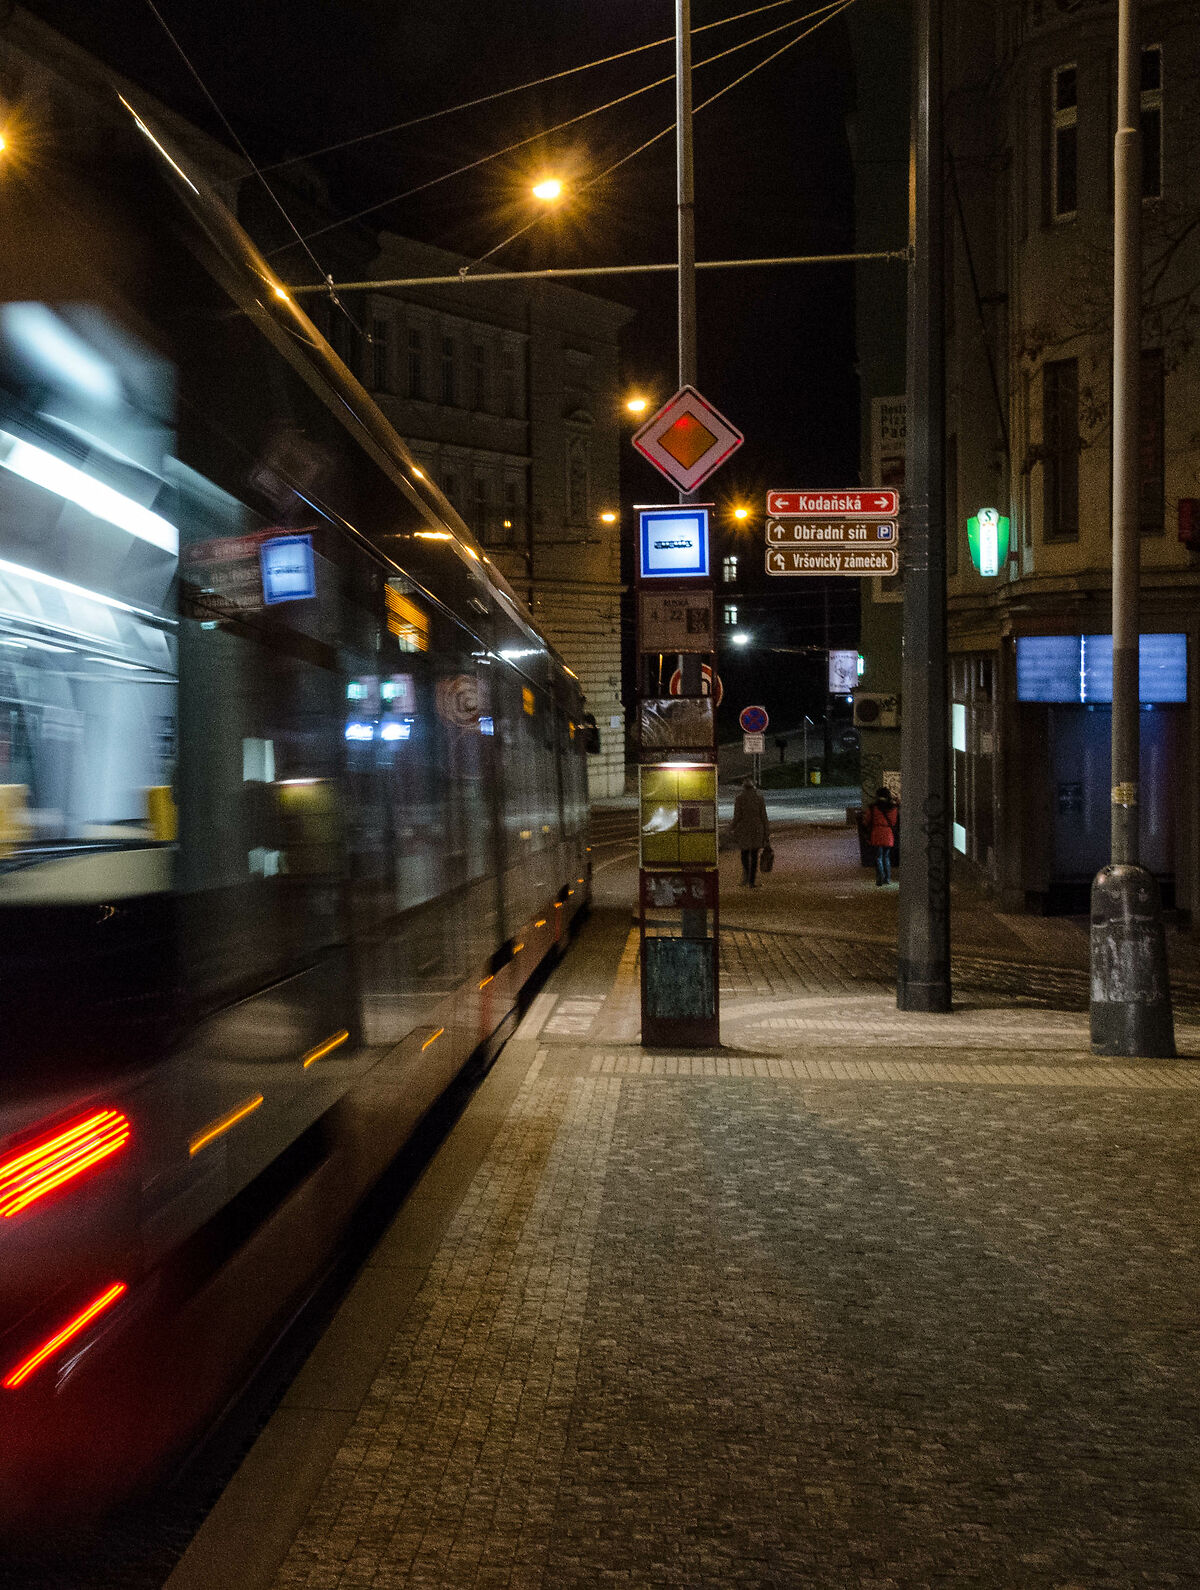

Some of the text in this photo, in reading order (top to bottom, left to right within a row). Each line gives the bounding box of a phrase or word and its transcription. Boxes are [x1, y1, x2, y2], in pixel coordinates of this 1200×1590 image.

[799, 495, 862, 511] Kodaňská
[793, 524, 844, 540] Obřadní
[848, 524, 867, 540] síň
[793, 553, 889, 571] Vršovický zámeček
